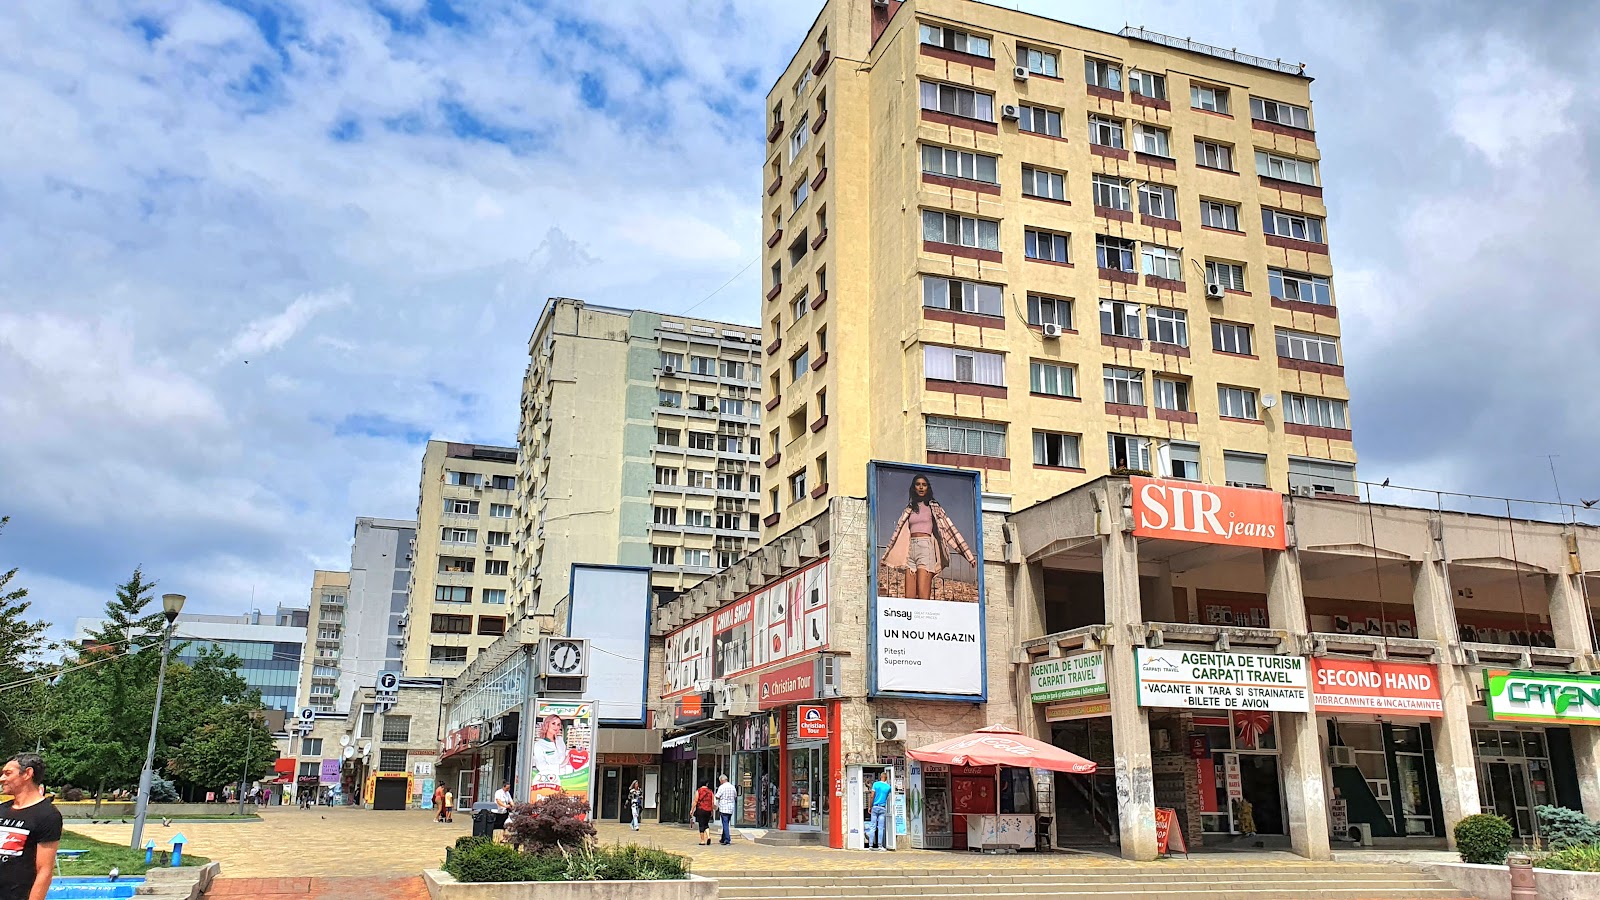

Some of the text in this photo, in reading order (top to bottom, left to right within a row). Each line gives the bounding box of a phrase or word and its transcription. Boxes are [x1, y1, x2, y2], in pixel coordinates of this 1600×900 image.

[1140, 484, 1276, 539] SIR jeans
[716, 600, 752, 632] CHINA SHOP
[884, 608, 912, 620] sinsay
[884, 629, 975, 642] UN NOU MAGAZIN
[884, 648, 906, 656] Pitești
[884, 658, 922, 666] Supernova
[1030, 654, 1103, 677] AGENTIA DE TURISM
[1238, 656, 1254, 667] DE
[1255, 657, 1301, 670] TURISM
[1037, 669, 1096, 688] CARPATI TRAVEL
[1247, 670, 1293, 683] TRAVEL
[1317, 669, 1431, 691] SECOND HAND
[771, 676, 811, 696] Christian Tour
[1148, 684, 1305, 699] VACANTE IN TARA SI STRAINATATE
[1188, 696, 1269, 708] BILETE DE AVION
[1376, 699, 1383, 707] &
[1384, 699, 1440, 710] INCALTAMINTE
